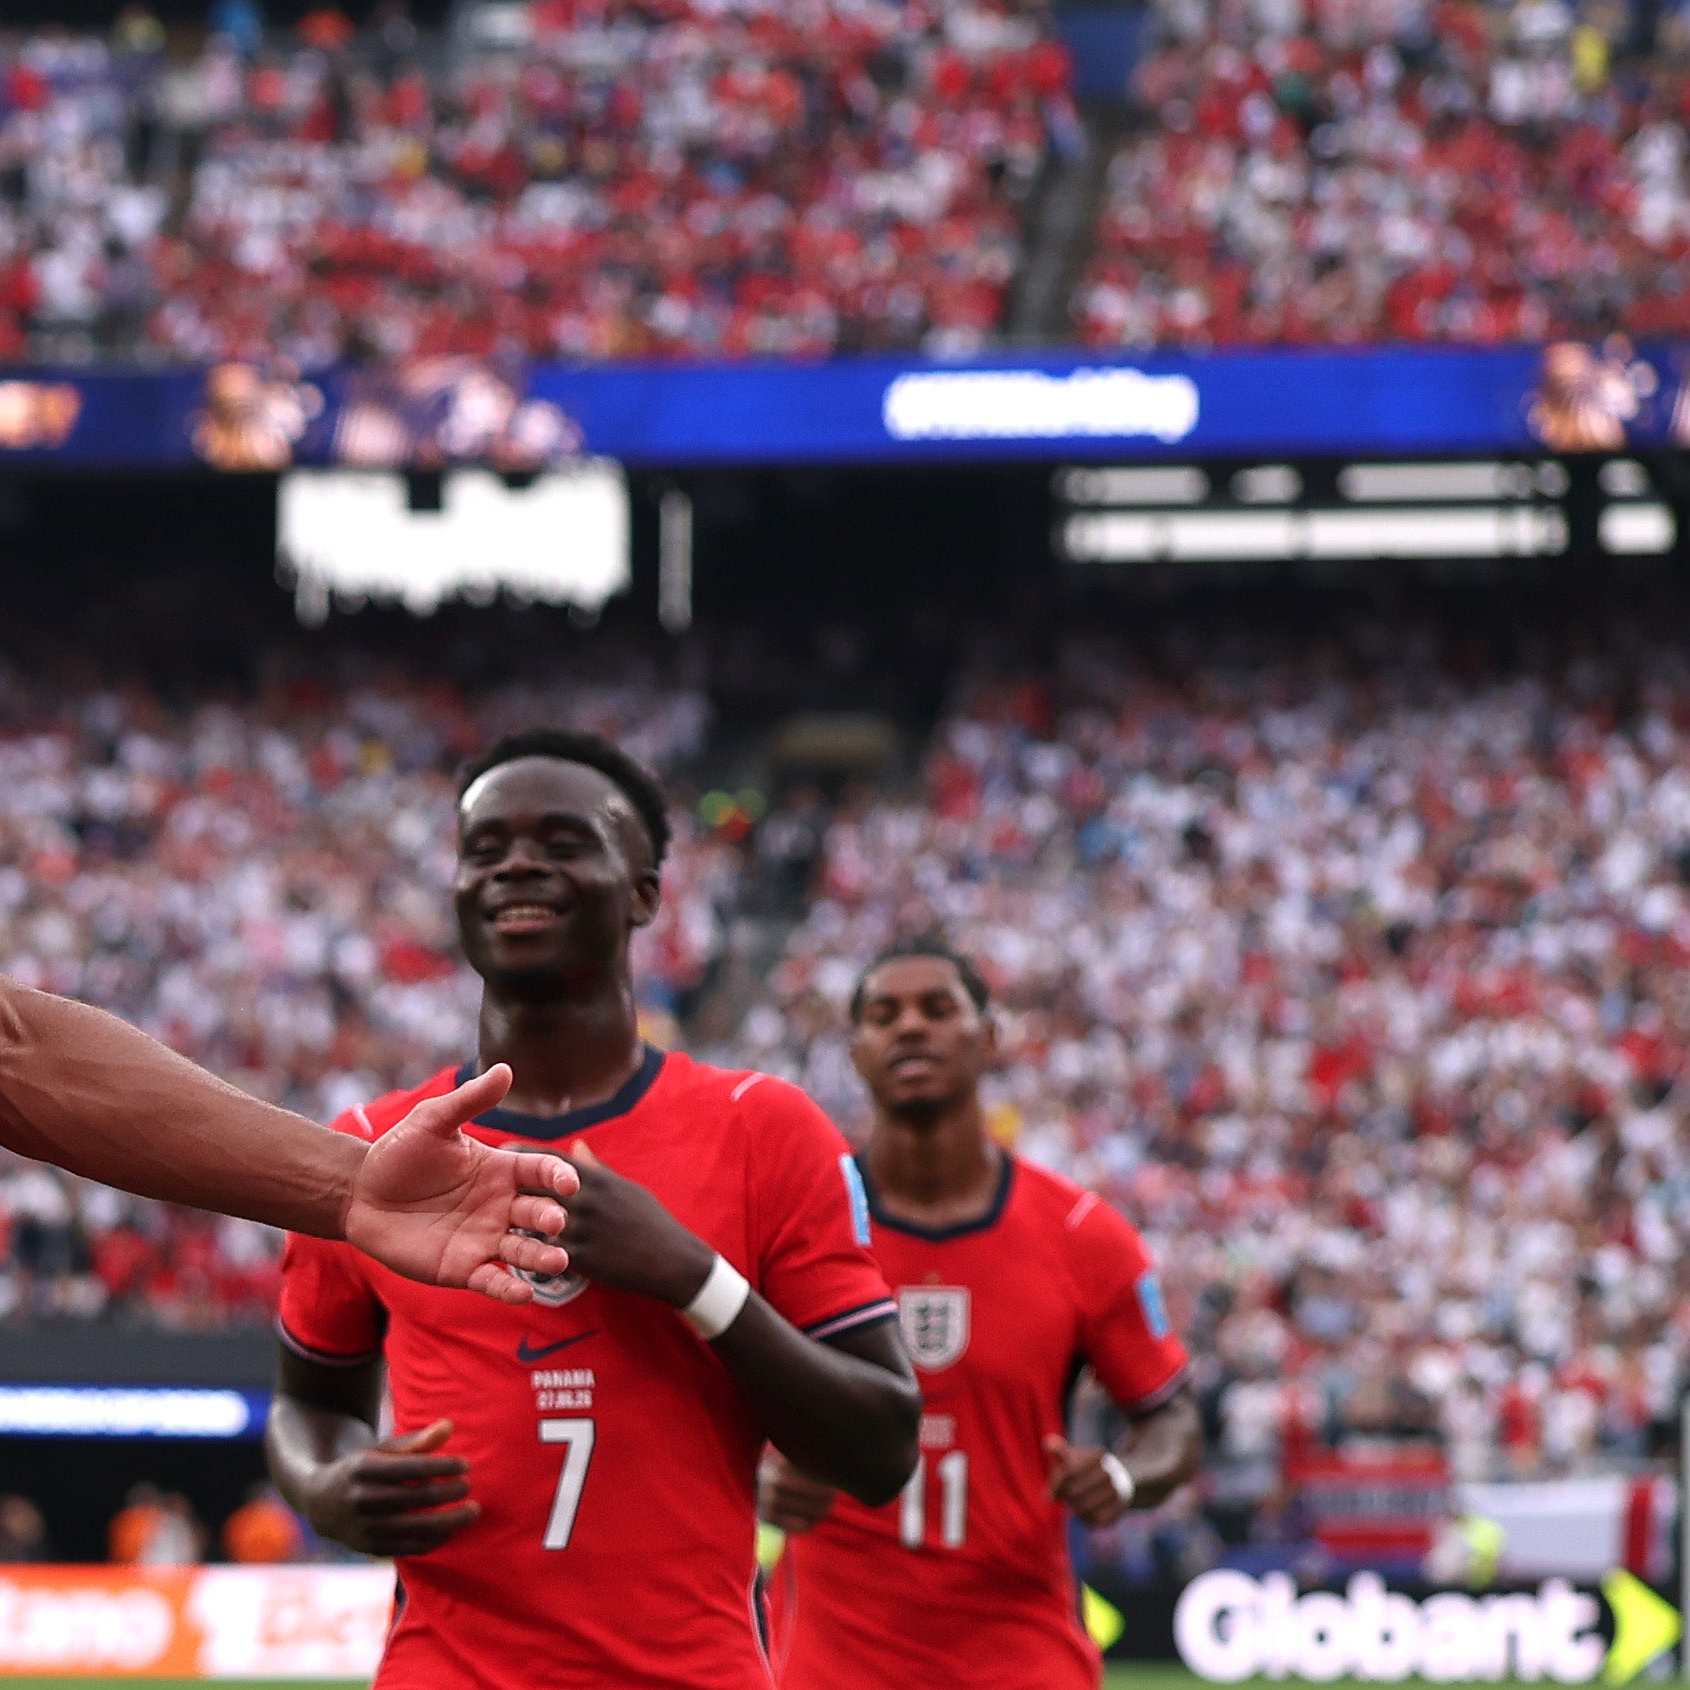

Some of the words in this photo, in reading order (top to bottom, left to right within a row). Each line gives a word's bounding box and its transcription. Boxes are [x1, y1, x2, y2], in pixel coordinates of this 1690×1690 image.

[531, 1368, 596, 1390] PANAMA
[537, 1417, 596, 1551] 7
[898, 1449, 969, 1550] 11
[1172, 1567, 1606, 1684] Globant
